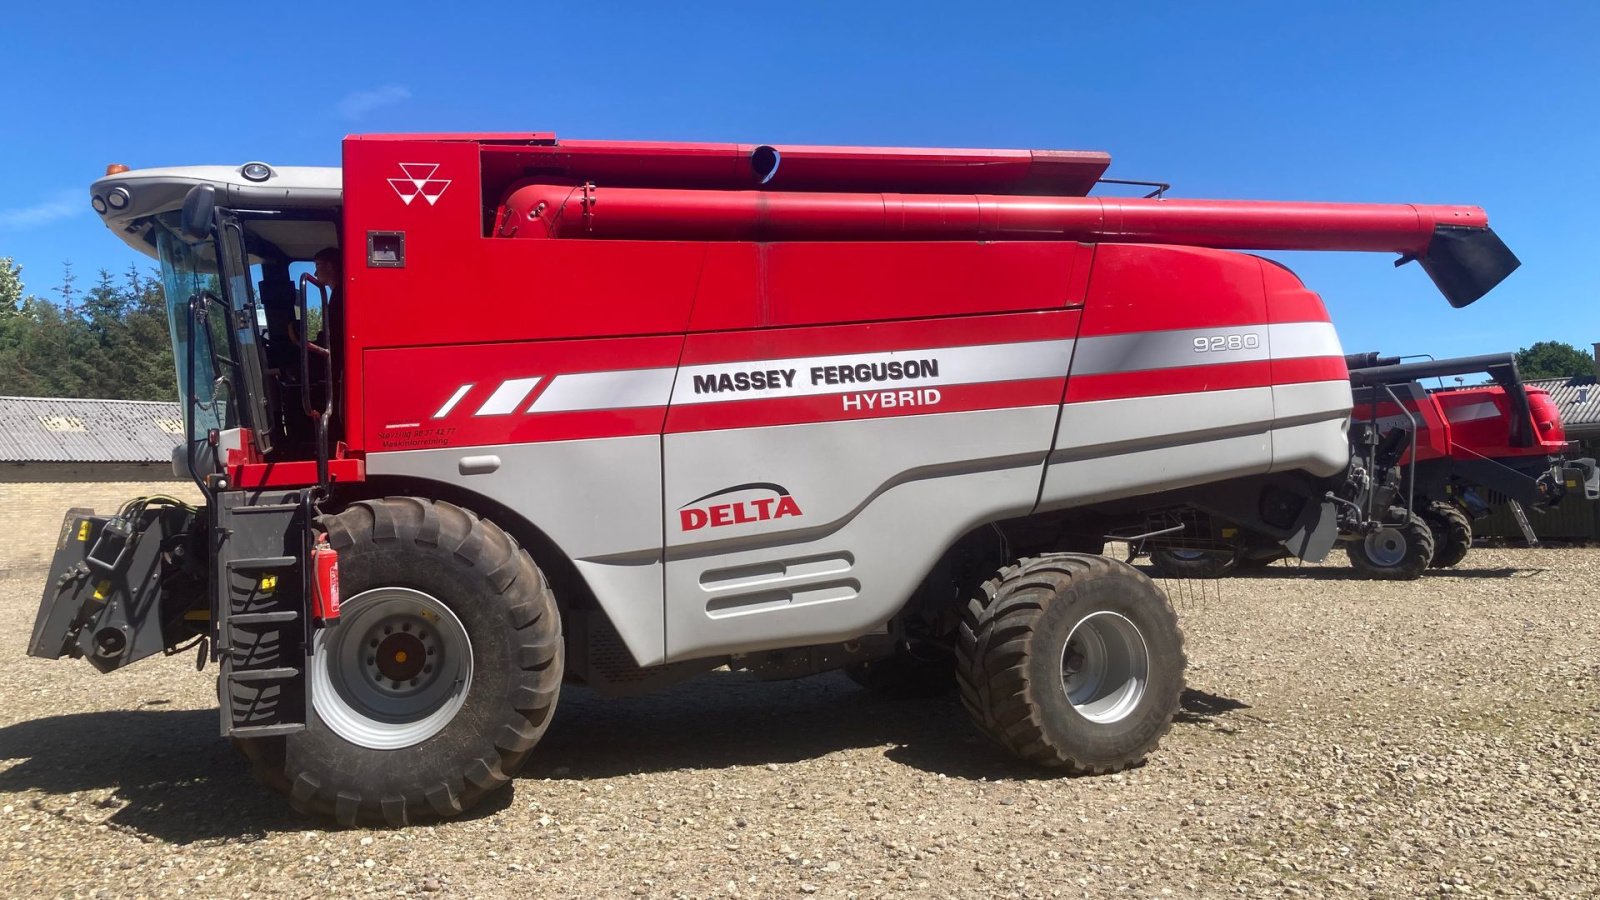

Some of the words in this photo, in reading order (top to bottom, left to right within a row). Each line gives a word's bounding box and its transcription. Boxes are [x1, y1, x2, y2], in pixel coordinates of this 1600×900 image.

[1193, 333, 1259, 353] 9280
[693, 368, 797, 394] MASSEY
[810, 358, 939, 386] FERGUSON
[842, 388, 941, 411] HYBRID
[680, 496, 803, 531] DELTA
